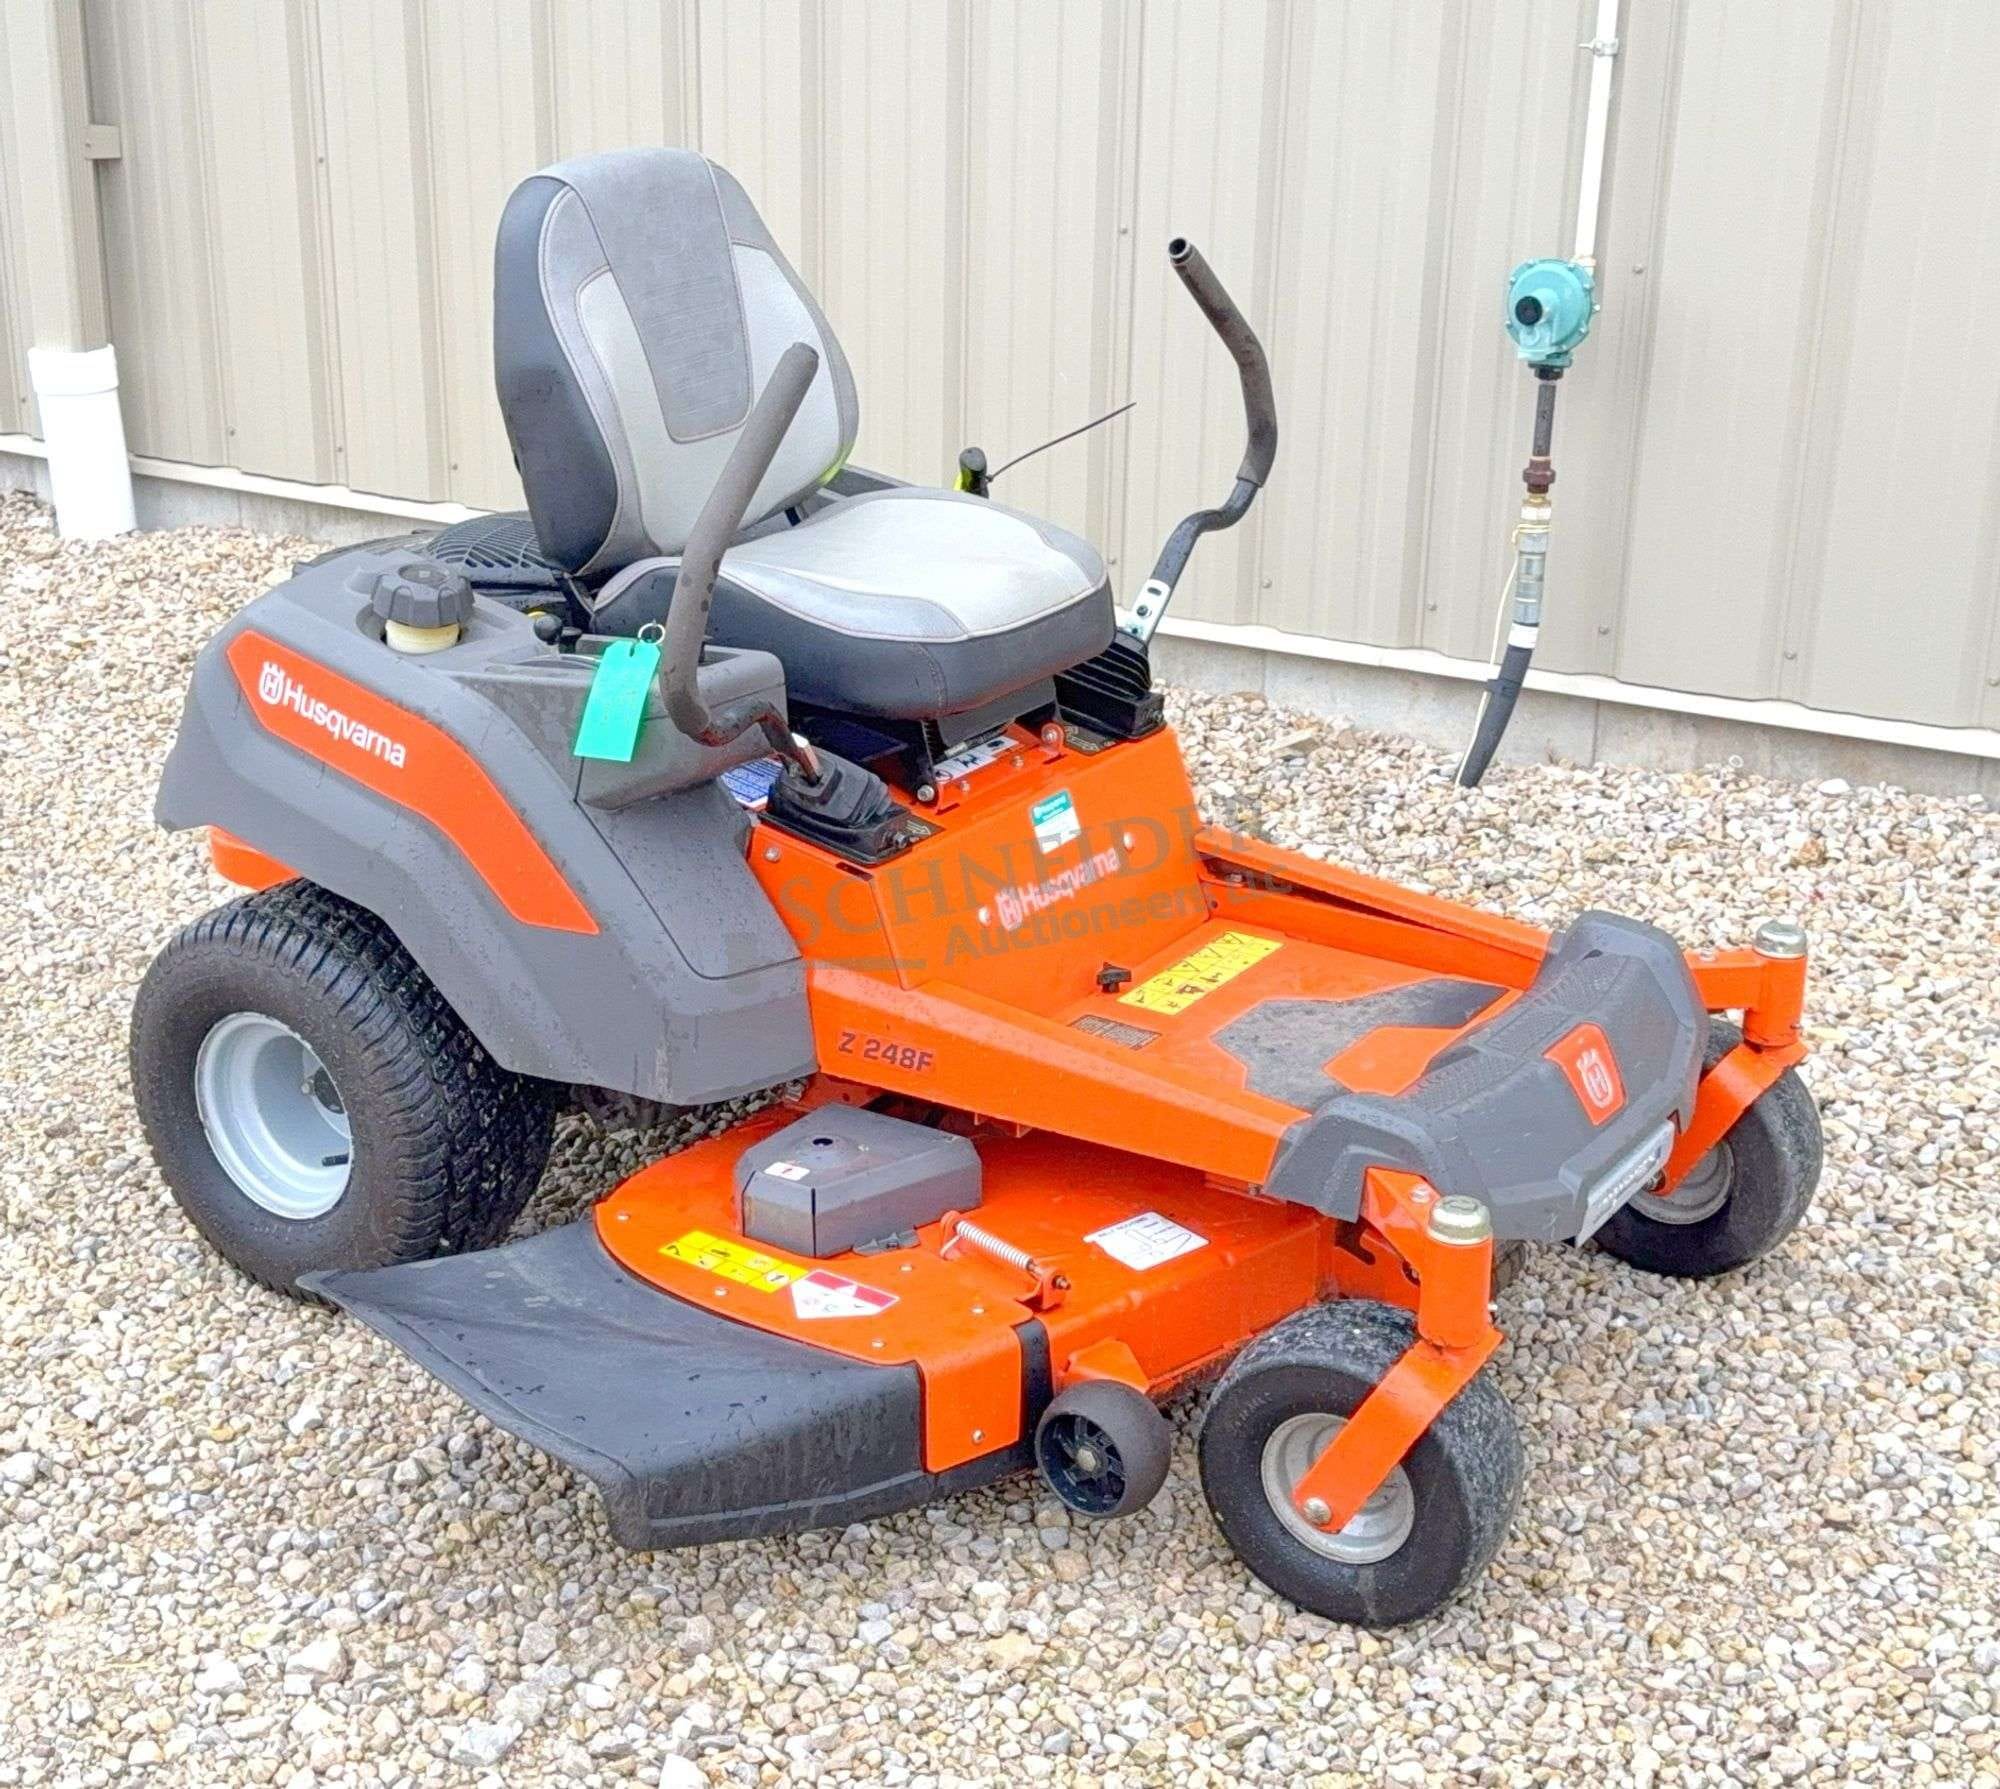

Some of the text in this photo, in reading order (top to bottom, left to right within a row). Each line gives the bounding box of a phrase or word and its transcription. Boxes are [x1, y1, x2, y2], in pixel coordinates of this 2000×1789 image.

[283, 677, 407, 769] Husqvarna
[1017, 847, 1120, 917] Husqvarna
[838, 1031, 933, 1071] Z 248F
